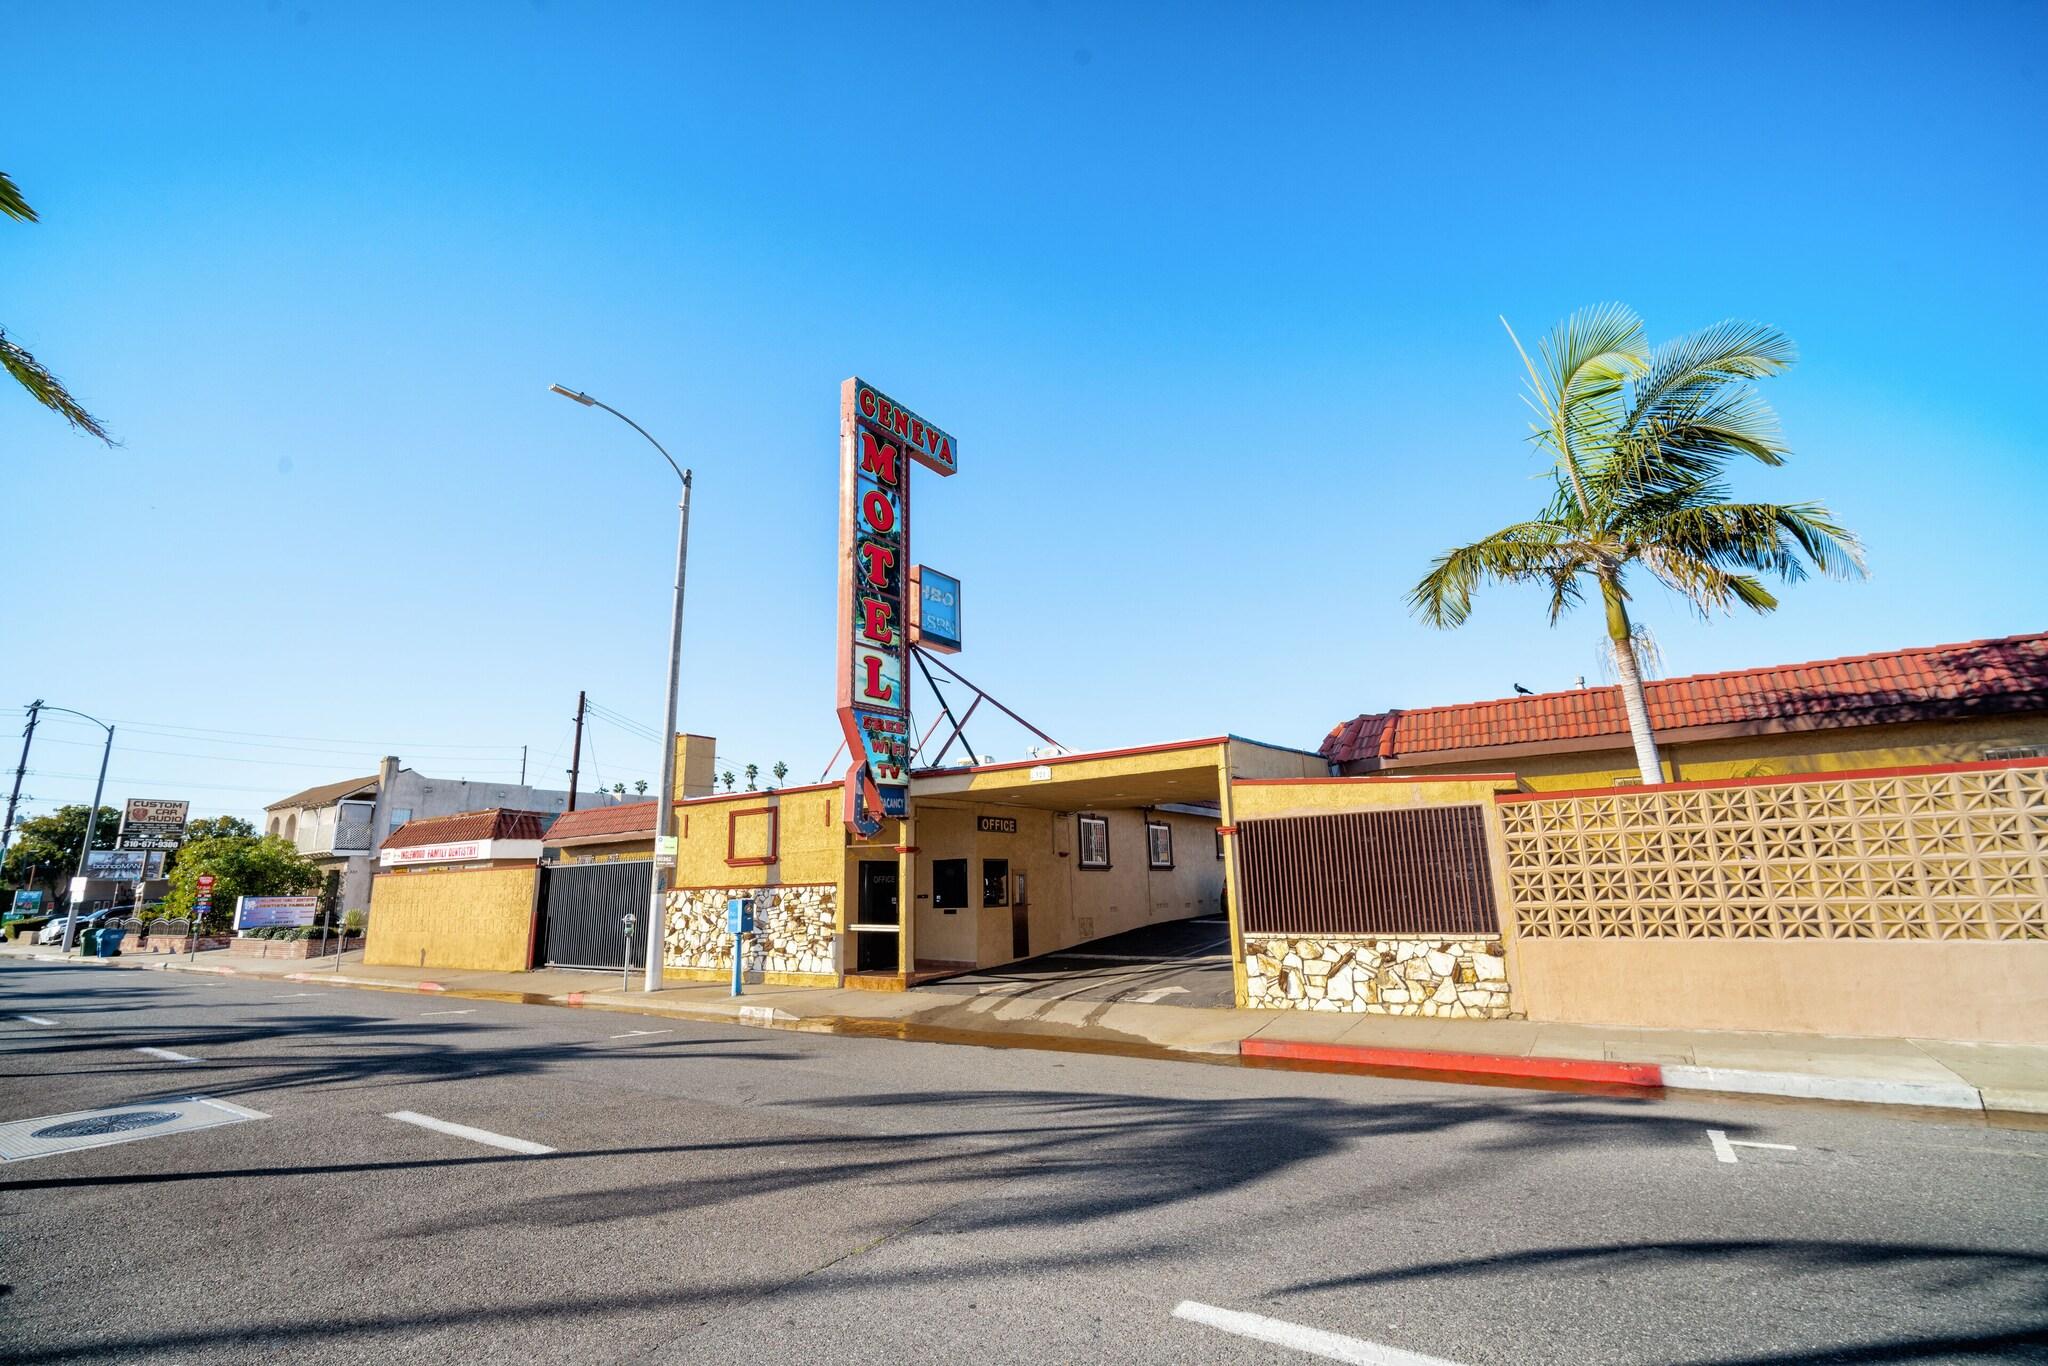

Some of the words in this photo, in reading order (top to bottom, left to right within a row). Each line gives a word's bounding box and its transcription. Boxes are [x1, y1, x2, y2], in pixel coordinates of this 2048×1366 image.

[859, 388, 954, 465] GENEVA
[861, 432, 897, 701] MOTEL
[863, 716, 906, 734] FREE
[878, 764, 900, 779] TV
[133, 800, 183, 809] CUSTOM
[147, 815, 183, 823] AUDIO
[155, 808, 178, 816] CAR
[982, 818, 1015, 832] OFFICE
[872, 875, 896, 884] OFFICE
